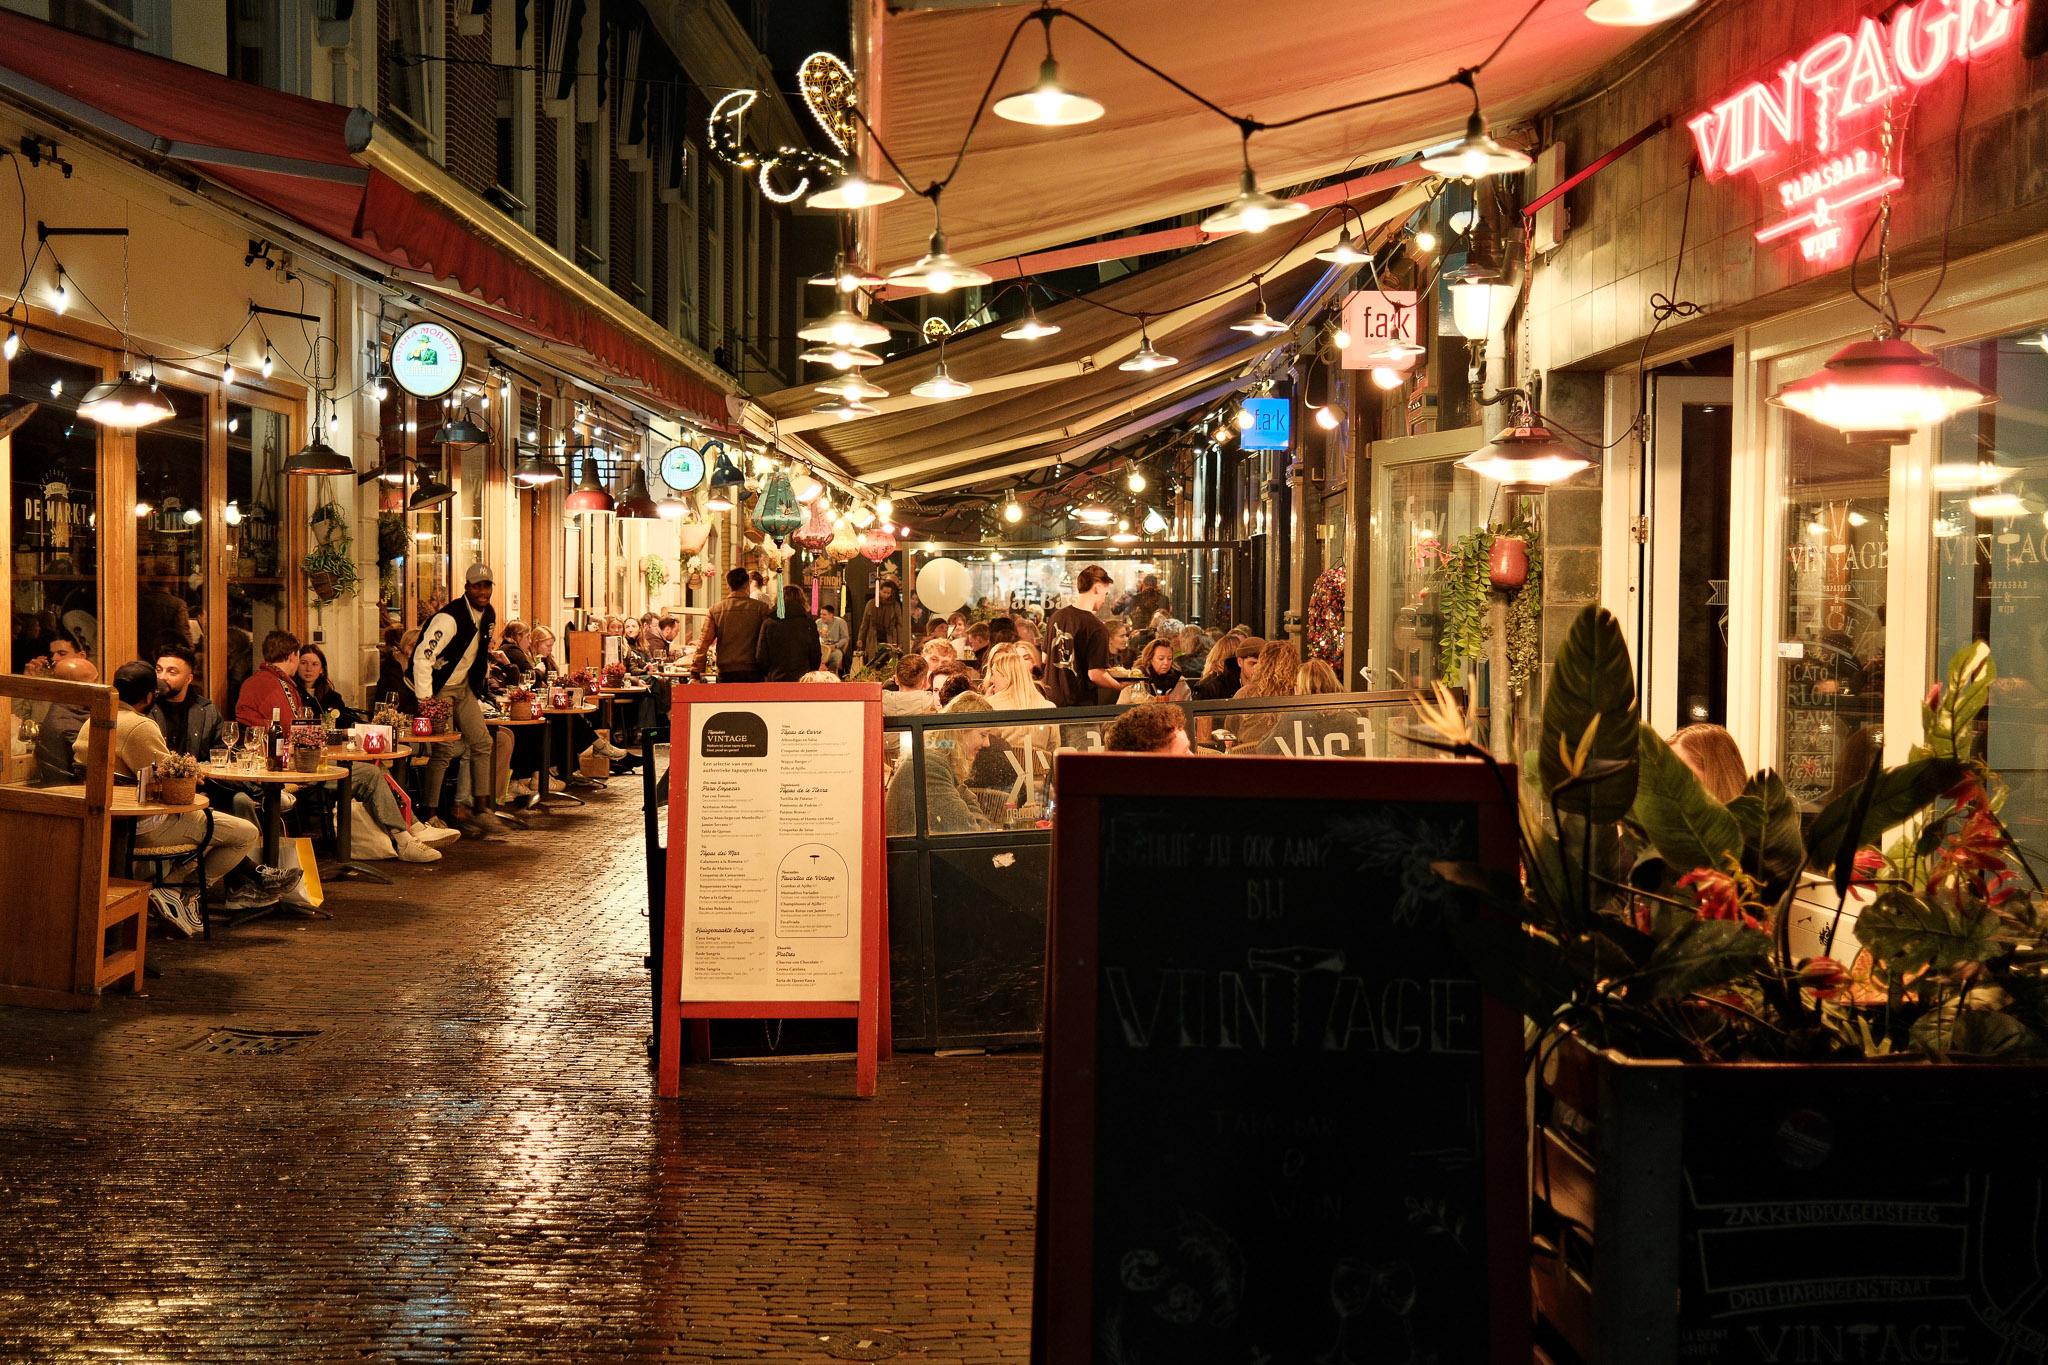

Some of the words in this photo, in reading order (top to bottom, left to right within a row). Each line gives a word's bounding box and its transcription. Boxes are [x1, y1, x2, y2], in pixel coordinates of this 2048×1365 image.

[1687, 0, 2023, 182] VINTAGE
[24, 497, 41, 521] DE
[46, 500, 87, 525] MARKT
[1247, 877, 1286, 921] BIJ
[1104, 950, 1482, 1053] VINTAGE
[1746, 1323, 1969, 1364] VINTAGE
